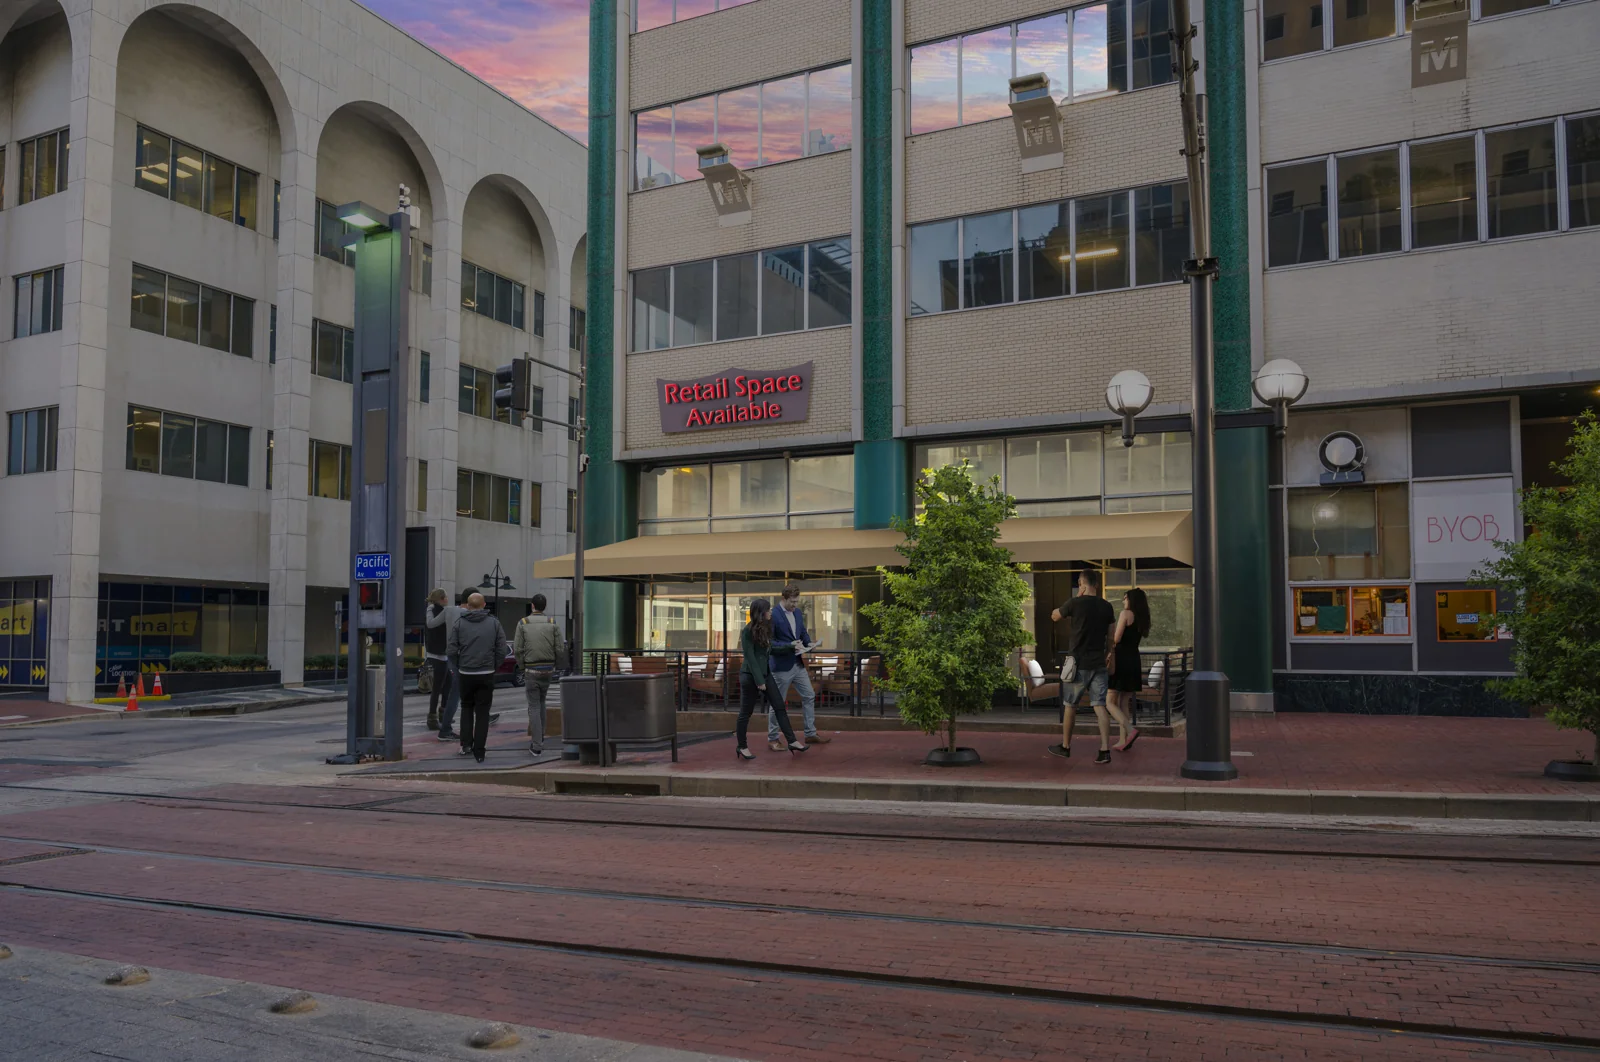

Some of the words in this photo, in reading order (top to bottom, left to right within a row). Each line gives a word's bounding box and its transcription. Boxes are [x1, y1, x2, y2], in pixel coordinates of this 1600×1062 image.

[664, 377, 729, 404] Retail
[734, 374, 802, 401] Space
[686, 401, 781, 427] Available
[1427, 514, 1500, 543] BYOB
[357, 556, 388, 568] Pacific
[135, 620, 189, 632] mart
